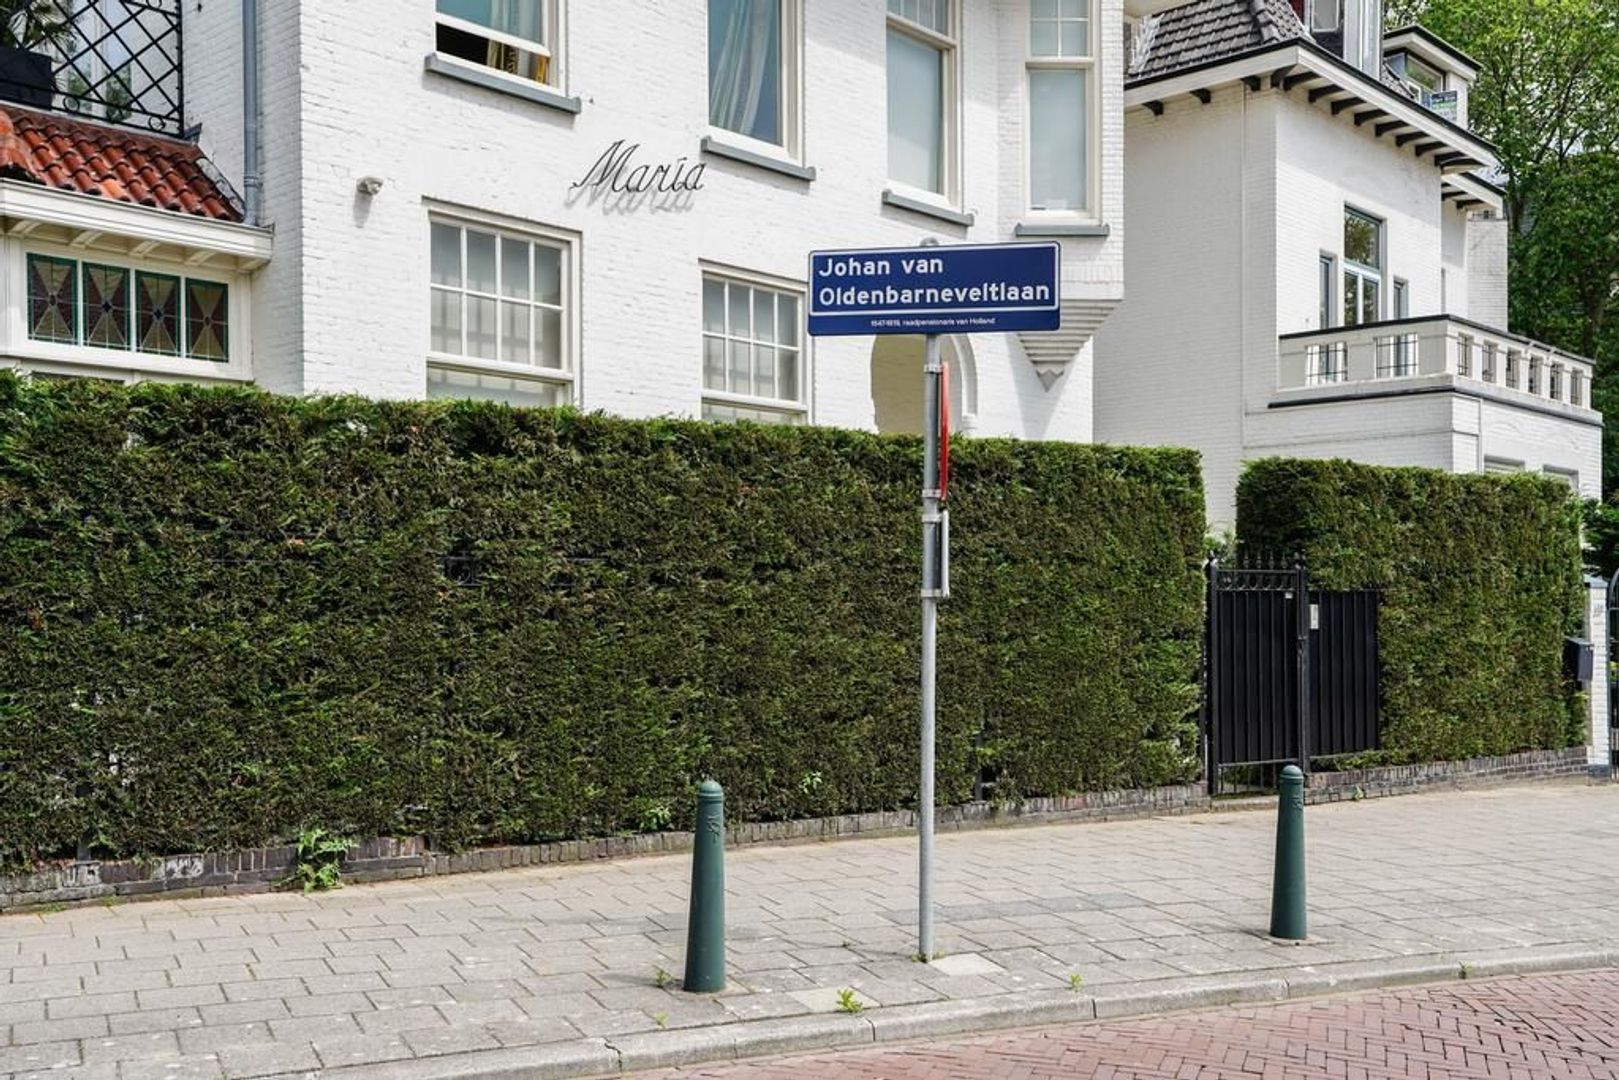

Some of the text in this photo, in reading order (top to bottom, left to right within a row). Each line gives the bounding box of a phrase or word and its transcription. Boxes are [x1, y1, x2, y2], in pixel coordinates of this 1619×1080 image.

[569, 139, 706, 193] Maria
[819, 258, 944, 277] Johan van
[819, 283, 1050, 306] Oldenbarneveltlaan
[970, 317, 995, 325] Holland
